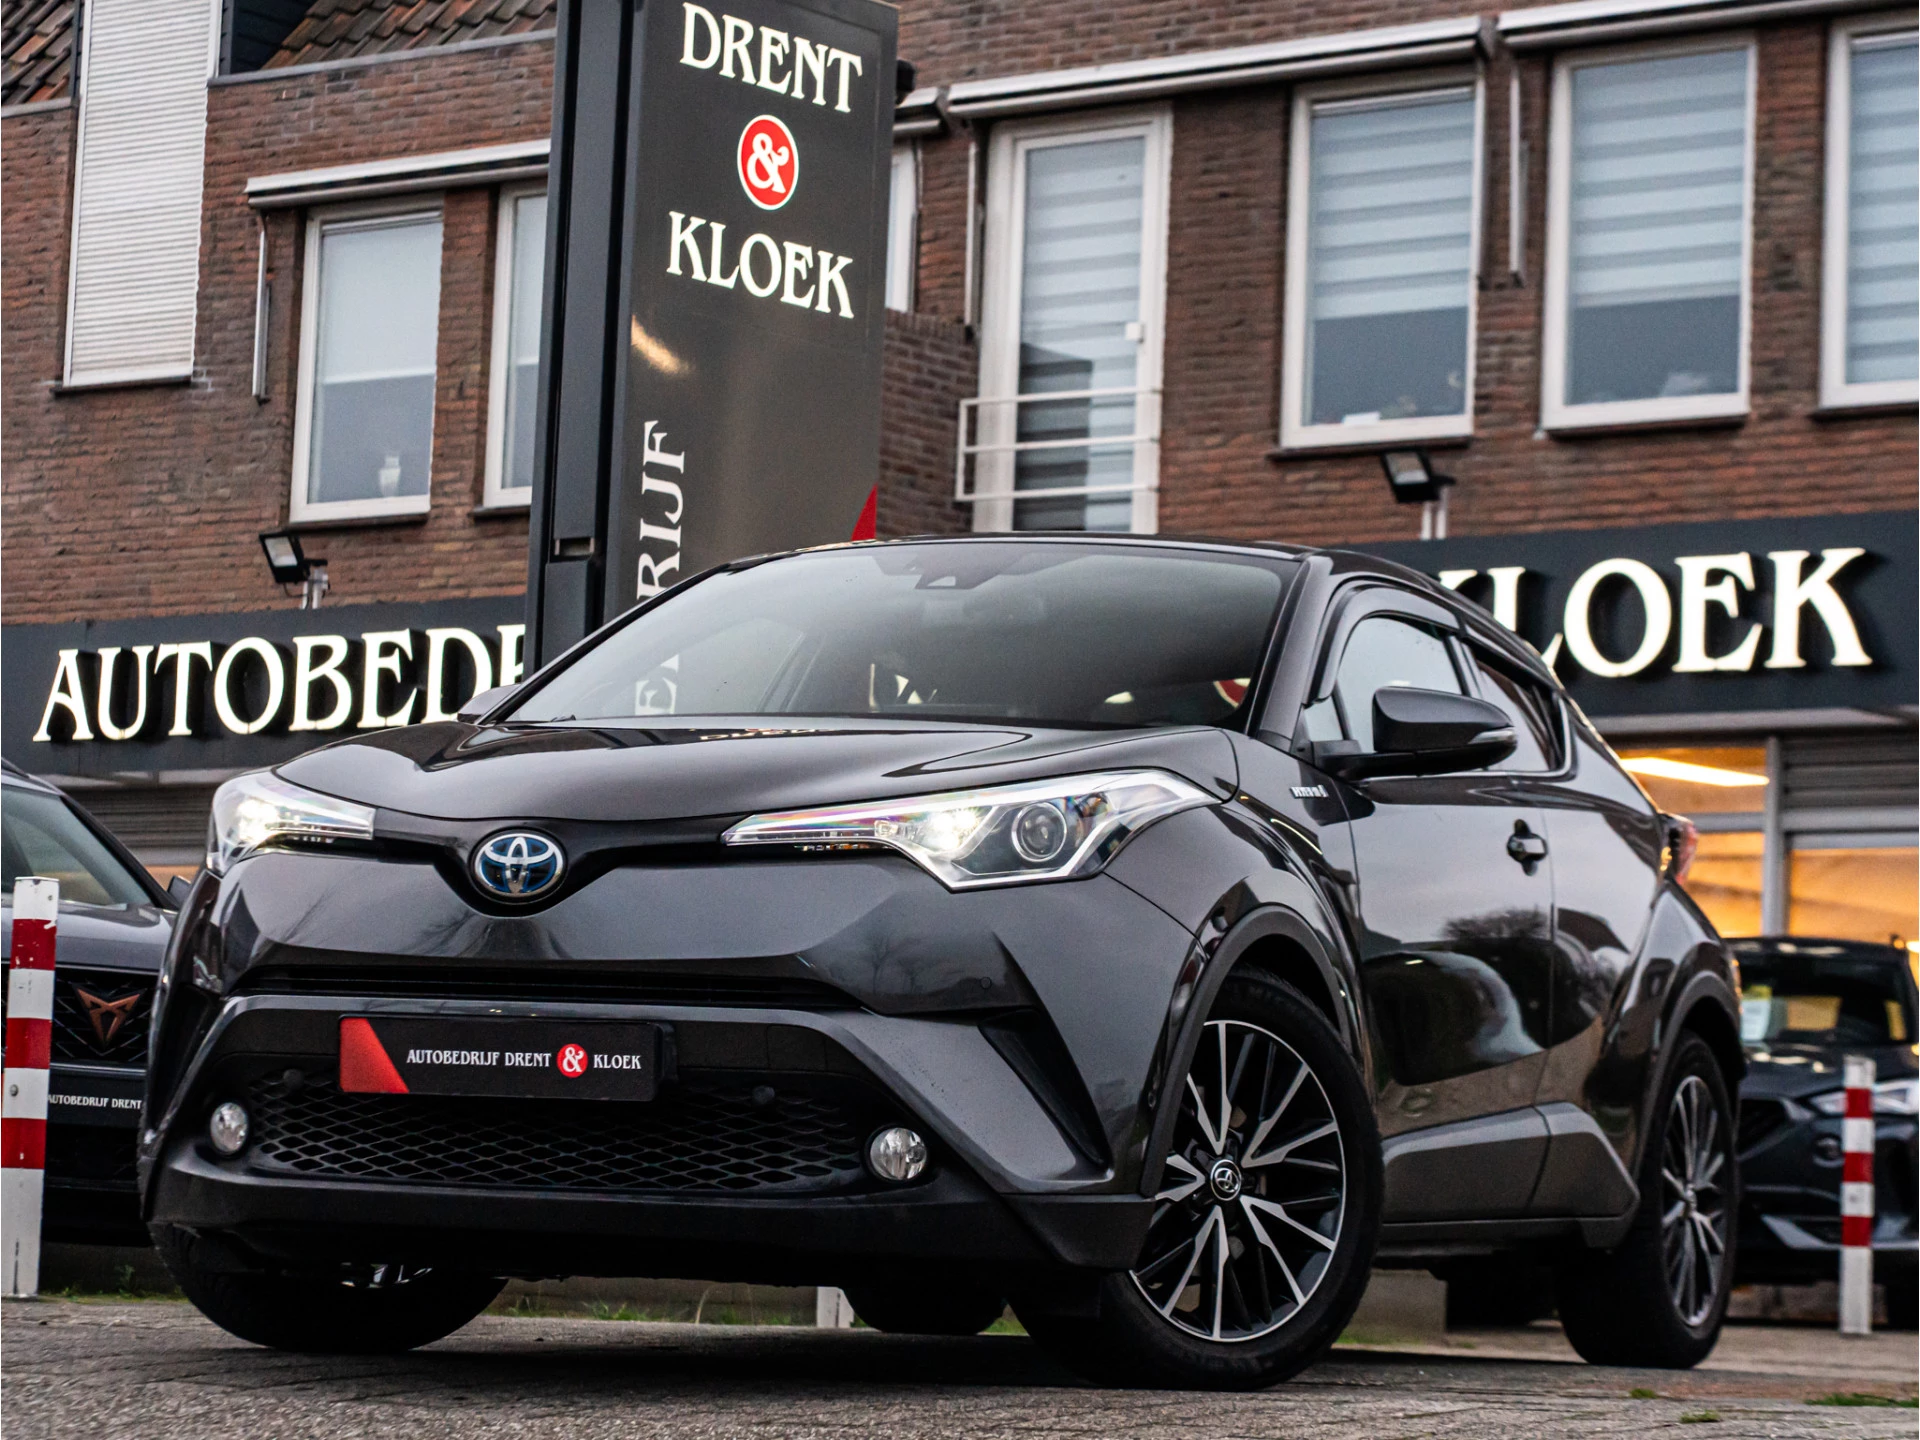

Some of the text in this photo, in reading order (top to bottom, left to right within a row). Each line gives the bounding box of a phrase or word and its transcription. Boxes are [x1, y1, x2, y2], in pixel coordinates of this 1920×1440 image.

[680, 2, 863, 113] DRENT
[666, 210, 854, 319] KLOEK
[1439, 546, 1873, 678] LOEK
[32, 623, 526, 742] AUTOBED
[111, 1098, 142, 1110] DRENT
[406, 1046, 642, 1073] AUTOBEDRIJF DRENT & KLOEK
